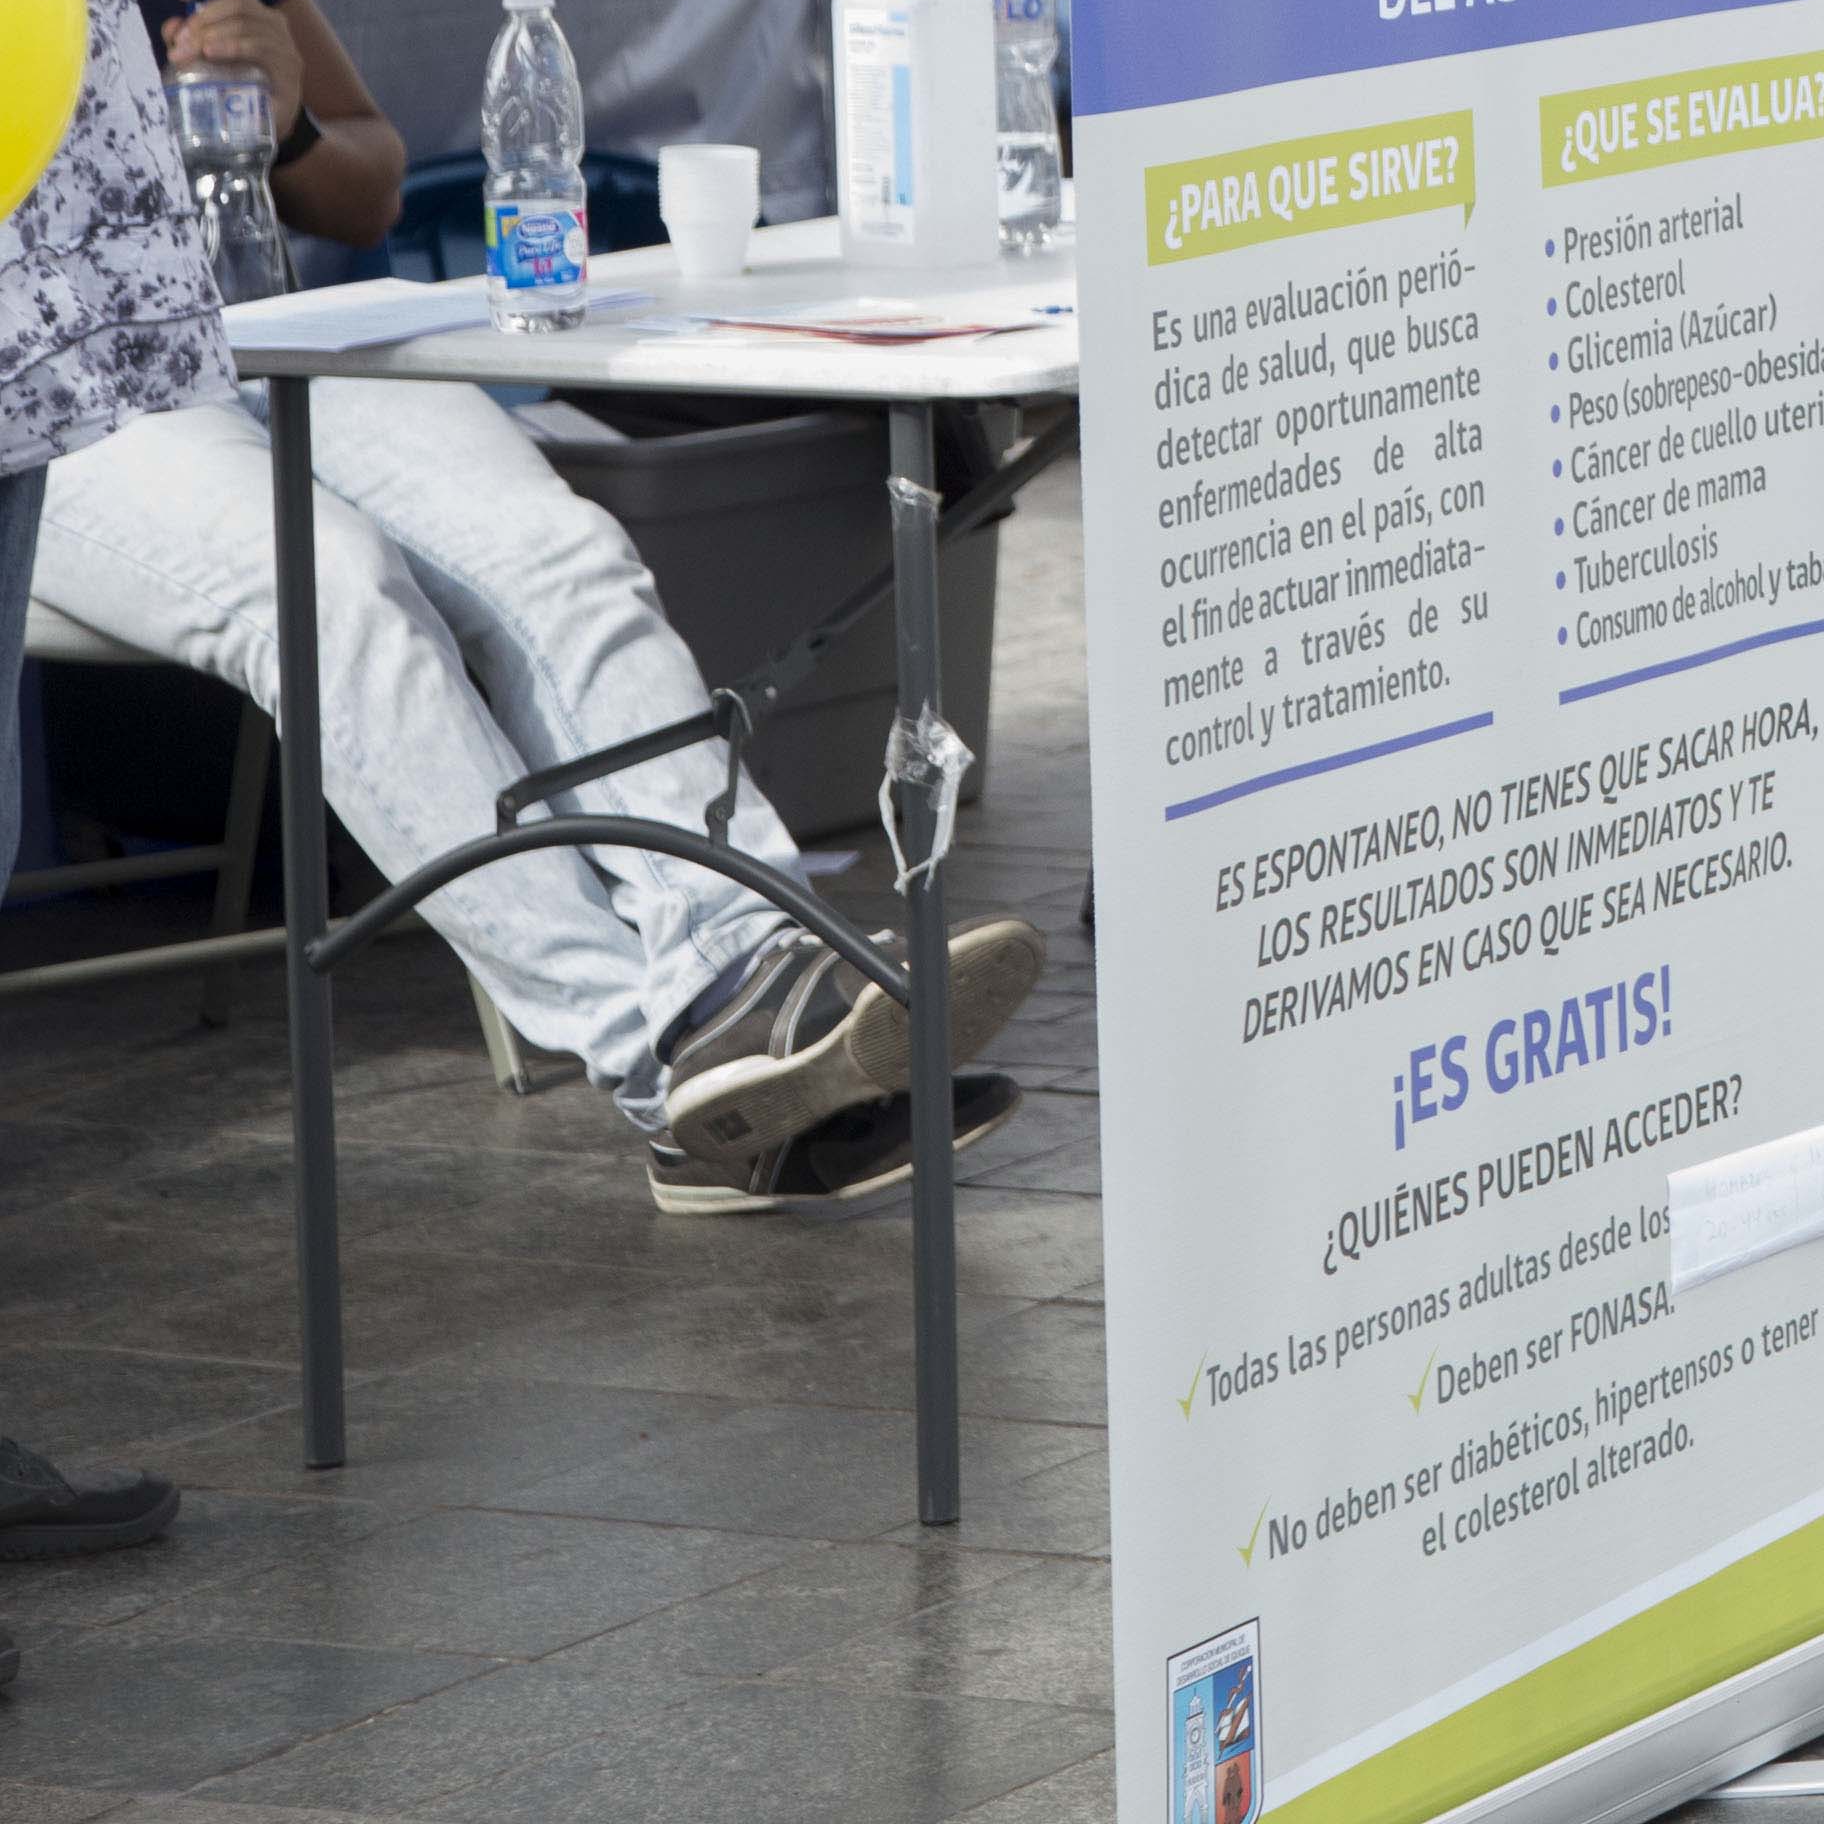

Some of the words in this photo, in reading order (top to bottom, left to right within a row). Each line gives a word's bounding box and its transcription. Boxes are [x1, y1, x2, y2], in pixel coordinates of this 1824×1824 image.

[1560, 102, 1640, 173] ¿QUE
[1645, 95, 1682, 145] SE
[1163, 170, 1262, 251] ¿PARA
[1267, 156, 1340, 222] QUE
[1347, 135, 1460, 202] SIRVE?
[1564, 213, 1652, 264] Presión
[1658, 192, 1744, 245] arterial
[1152, 309, 1183, 352] Es
[1193, 305, 1237, 343] una
[1245, 266, 1388, 330] evaluación
[1398, 247, 1476, 309] perió-
[1565, 258, 1686, 319] Colesterol
[1567, 317, 1673, 374] Glicemia
[1679, 292, 1777, 350] (Azúcar)
[1154, 366, 1211, 411] dica
[1221, 353, 1249, 395] de
[1258, 332, 1335, 386] salud,
[1347, 329, 1396, 375] que
[1406, 312, 1479, 354] busca
[1569, 391, 1619, 430] Peso
[1156, 415, 1263, 470] detectar
[1276, 365, 1481, 447] oportunamente
[1571, 439, 1652, 484] Cáncer
[1658, 424, 1685, 464] de
[1691, 406, 1757, 455] cuello
[1158, 452, 1342, 529] enfermedades
[1373, 434, 1404, 475] de
[1434, 419, 1483, 461] alta
[1572, 492, 1656, 539] Cáncer
[1663, 477, 1690, 517] de
[1696, 465, 1766, 508] mama
[1160, 518, 1292, 589] ocurrencia
[1300, 516, 1333, 550] en
[1341, 497, 1367, 540] el
[1374, 485, 1433, 544] país,
[1440, 479, 1485, 516] con
[1573, 523, 1718, 594] Tuberculosis
[1162, 603, 1187, 648] el
[1191, 597, 1223, 641] fin
[1227, 587, 1254, 629] de
[1259, 571, 1340, 620] actuar
[1345, 537, 1486, 597] inmediata-
[1576, 600, 1668, 649] Consumo
[1672, 584, 1696, 623] de
[1699, 562, 1765, 616] alcohol
[1768, 567, 1782, 606] y
[1164, 655, 1244, 708] mente
[1264, 646, 1278, 677] a
[1300, 610, 1386, 666] través
[1408, 597, 1439, 638] de
[1461, 591, 1489, 625] su
[1165, 701, 1255, 766] control
[1260, 704, 1275, 748] y
[1282, 658, 1450, 730] tratamiento.
[1215, 860, 1246, 913] ES
[1252, 804, 1445, 900] ESPONTANEO,
[1452, 789, 1493, 840] NO
[1500, 760, 1592, 825] TIENES
[1599, 742, 1650, 805] QUE
[1656, 719, 1735, 780] SACAR
[1741, 697, 1819, 754] HORA,
[1257, 910, 1312, 968] LOS
[1319, 855, 1496, 949] RESULTADOS
[1501, 836, 1559, 893] SON
[1566, 787, 1723, 873] INMEDIATOS
[1729, 780, 1744, 822] Y
[1748, 769, 1776, 815] TE
[1242, 950, 1411, 1044] DERIVAMOS
[1417, 935, 1455, 988] EN
[1462, 912, 1532, 972] CASO
[1539, 892, 1595, 957] QUE
[1600, 876, 1646, 929] SEA
[1652, 831, 1793, 912] NECESARIO.
[1394, 1034, 1470, 1151] ¡ES
[1485, 964, 1672, 1095] GRATIS!
[1323, 1170, 1469, 1276] ¿QUIÉNES
[1478, 1125, 1594, 1208] PUEDEN
[1603, 1073, 1743, 1164] ACCEDER?
[1206, 1351, 1279, 1407] Todas
[1288, 1334, 1327, 1376] las
[1335, 1287, 1451, 1369] personas
[1458, 1249, 1551, 1311] adultas
[1558, 1215, 1632, 1273] desde
[1639, 1204, 1670, 1243] los
[1437, 1347, 1519, 1405] Deben
[1526, 1328, 1564, 1370] ser
[1570, 1280, 1675, 1353] FONASA.
[1268, 1514, 1308, 1560] No
[1315, 1481, 1396, 1541] deben
[1404, 1461, 1443, 1505] ser
[1450, 1406, 1589, 1485] diabéticos,
[1595, 1344, 1734, 1427] hipertensos
[1741, 1336, 1755, 1365] o
[1761, 1308, 1819, 1358] tener
[1422, 1511, 1447, 1557] el
[1454, 1456, 1580, 1544] colesterol
[1586, 1417, 1694, 1489] alterado.
